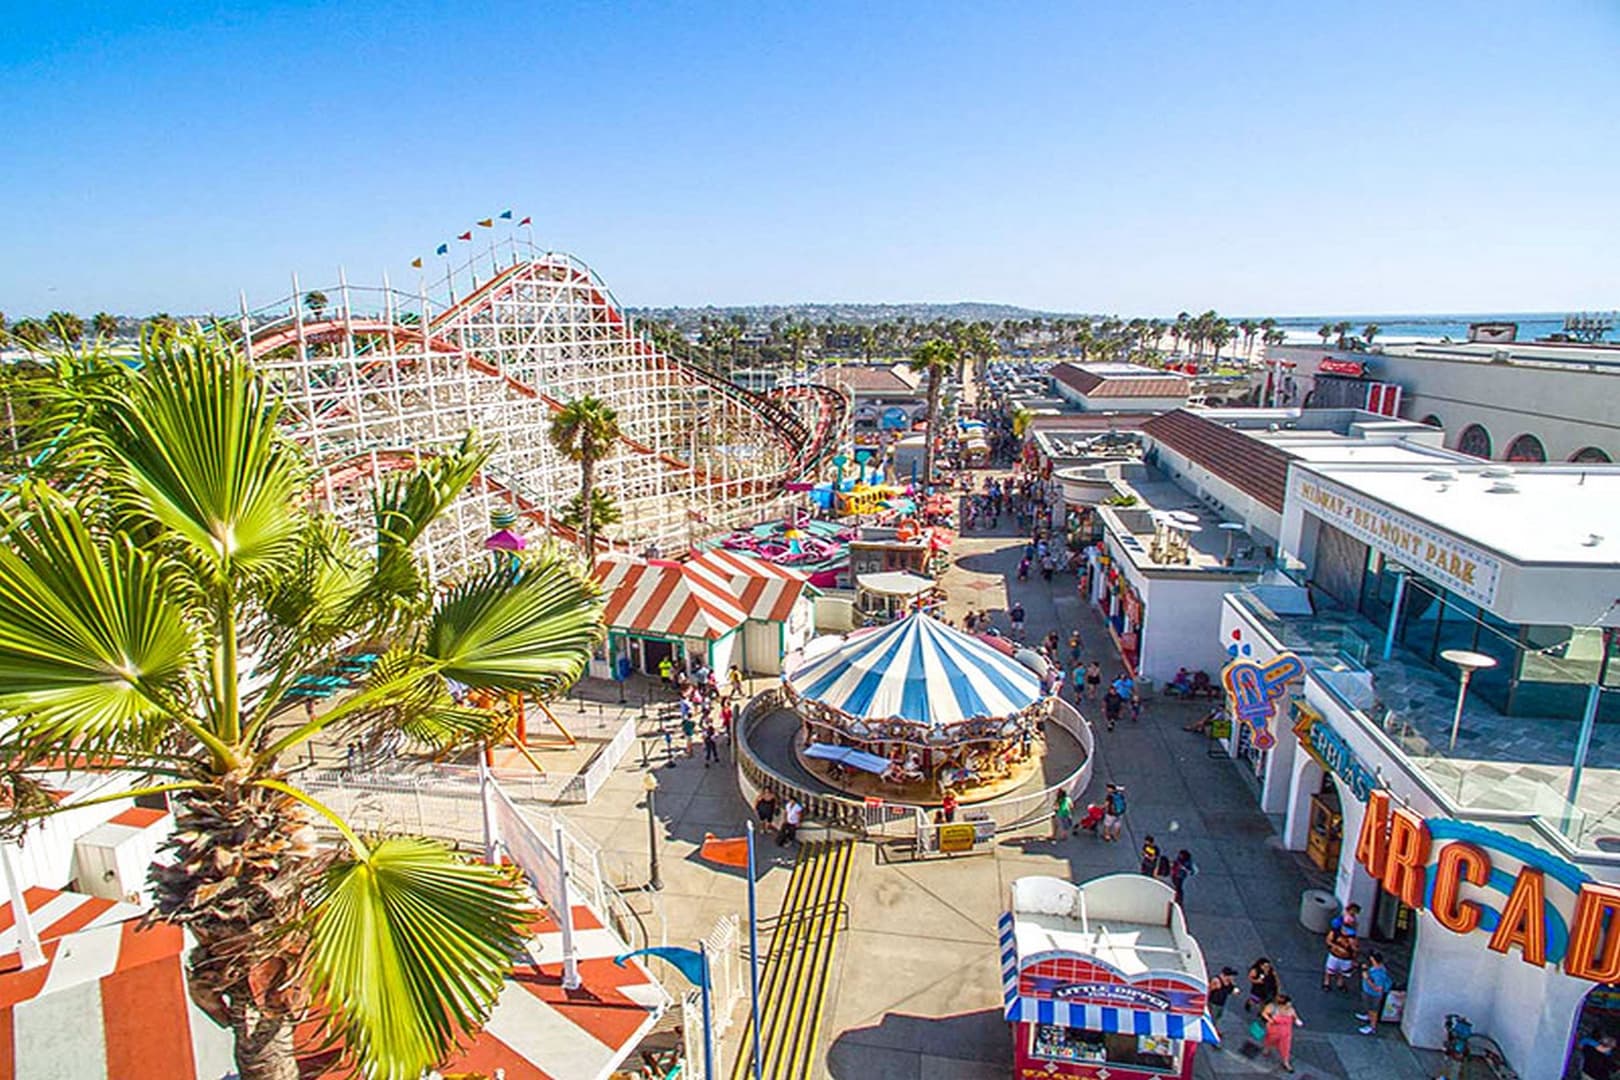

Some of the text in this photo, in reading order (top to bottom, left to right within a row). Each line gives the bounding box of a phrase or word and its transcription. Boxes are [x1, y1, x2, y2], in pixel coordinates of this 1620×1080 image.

[1301, 482, 1476, 586] MIDWAY BELMONT PARK
[1356, 789, 1620, 984] ARCAD
[1056, 985, 1107, 997] LITTLE
[1114, 986, 1169, 1010] DIPPER
